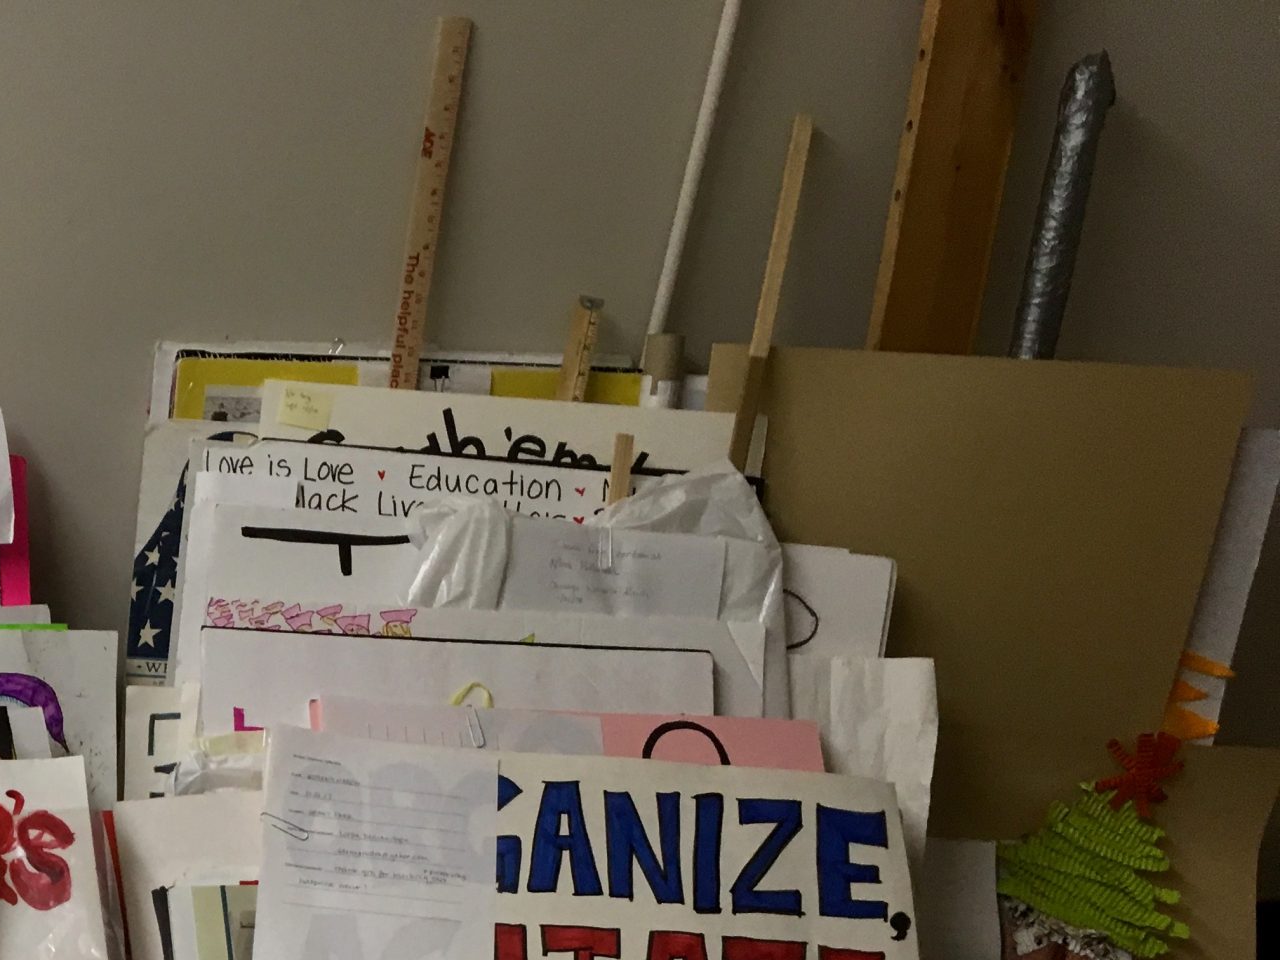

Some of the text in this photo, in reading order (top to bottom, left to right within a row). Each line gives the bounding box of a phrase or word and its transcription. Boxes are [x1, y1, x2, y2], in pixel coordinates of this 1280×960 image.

[389, 252, 419, 389] The helpful plac
[267, 453, 292, 478] is
[304, 457, 355, 485] Love
[408, 464, 562, 502] Education
